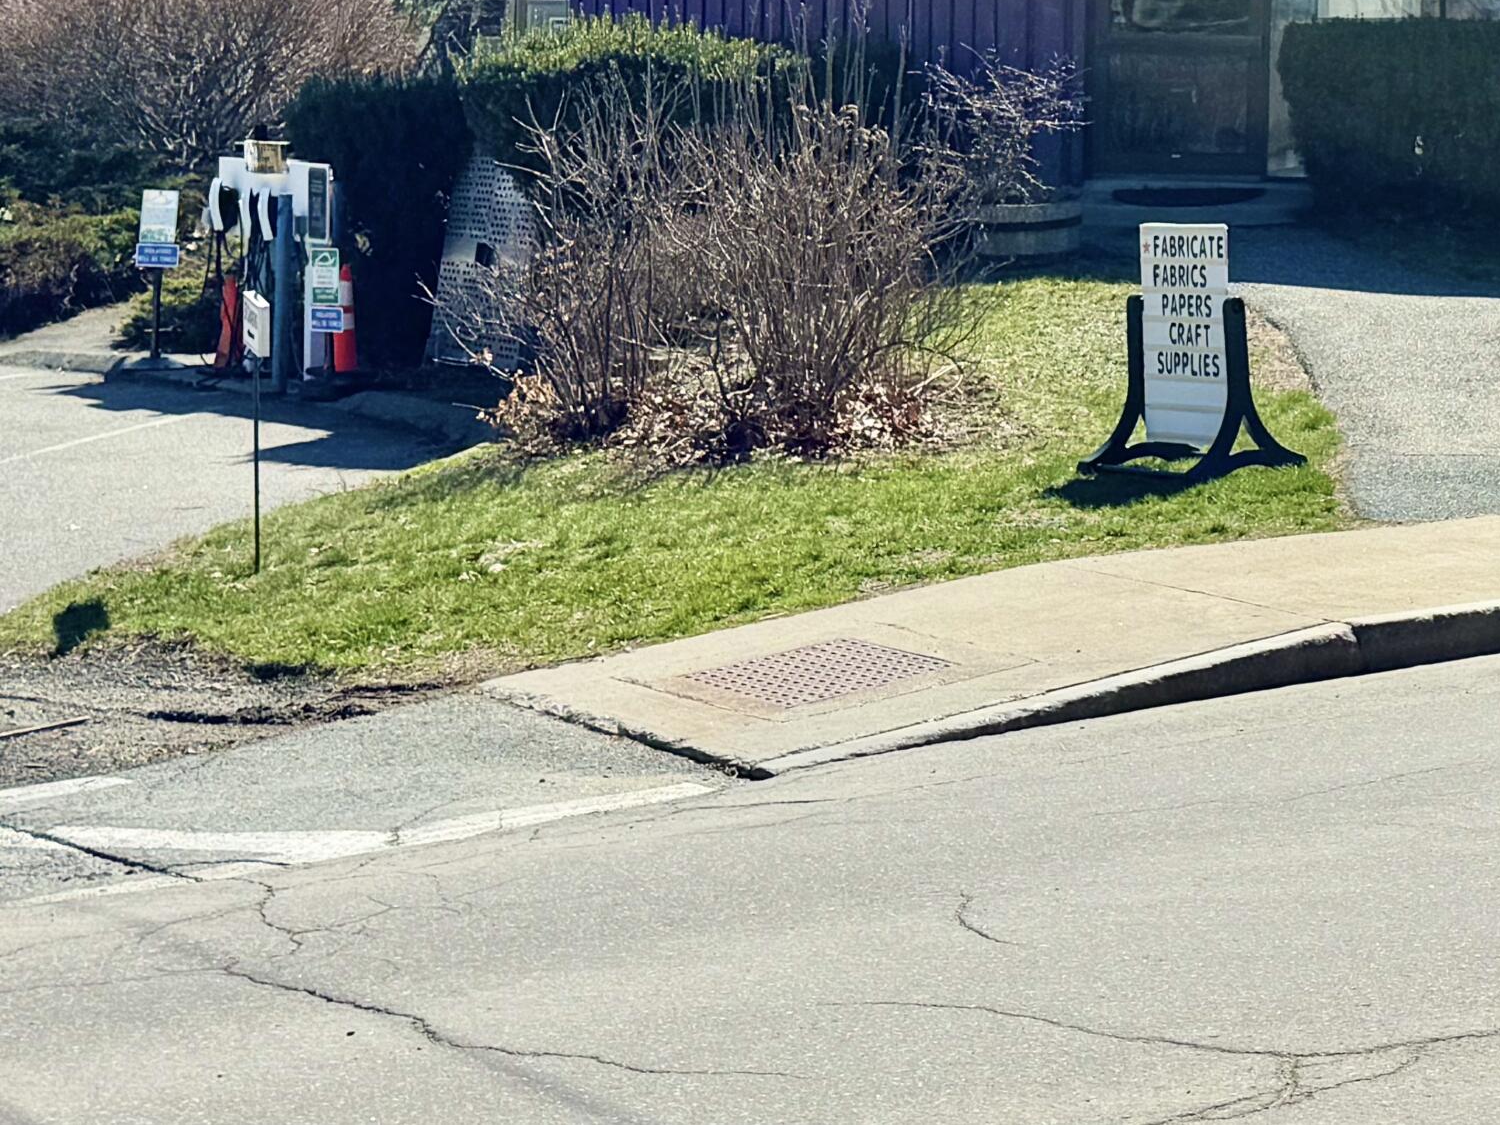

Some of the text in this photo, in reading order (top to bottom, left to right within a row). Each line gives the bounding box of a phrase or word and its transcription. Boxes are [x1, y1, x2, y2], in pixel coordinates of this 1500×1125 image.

[1153, 235, 1224, 259] FABRICATE
[1153, 264, 1207, 288] FABRICS
[1162, 294, 1212, 318] PAPERS
[1169, 322, 1211, 348] CRAFT
[1157, 351, 1220, 377] SUPPLIES
